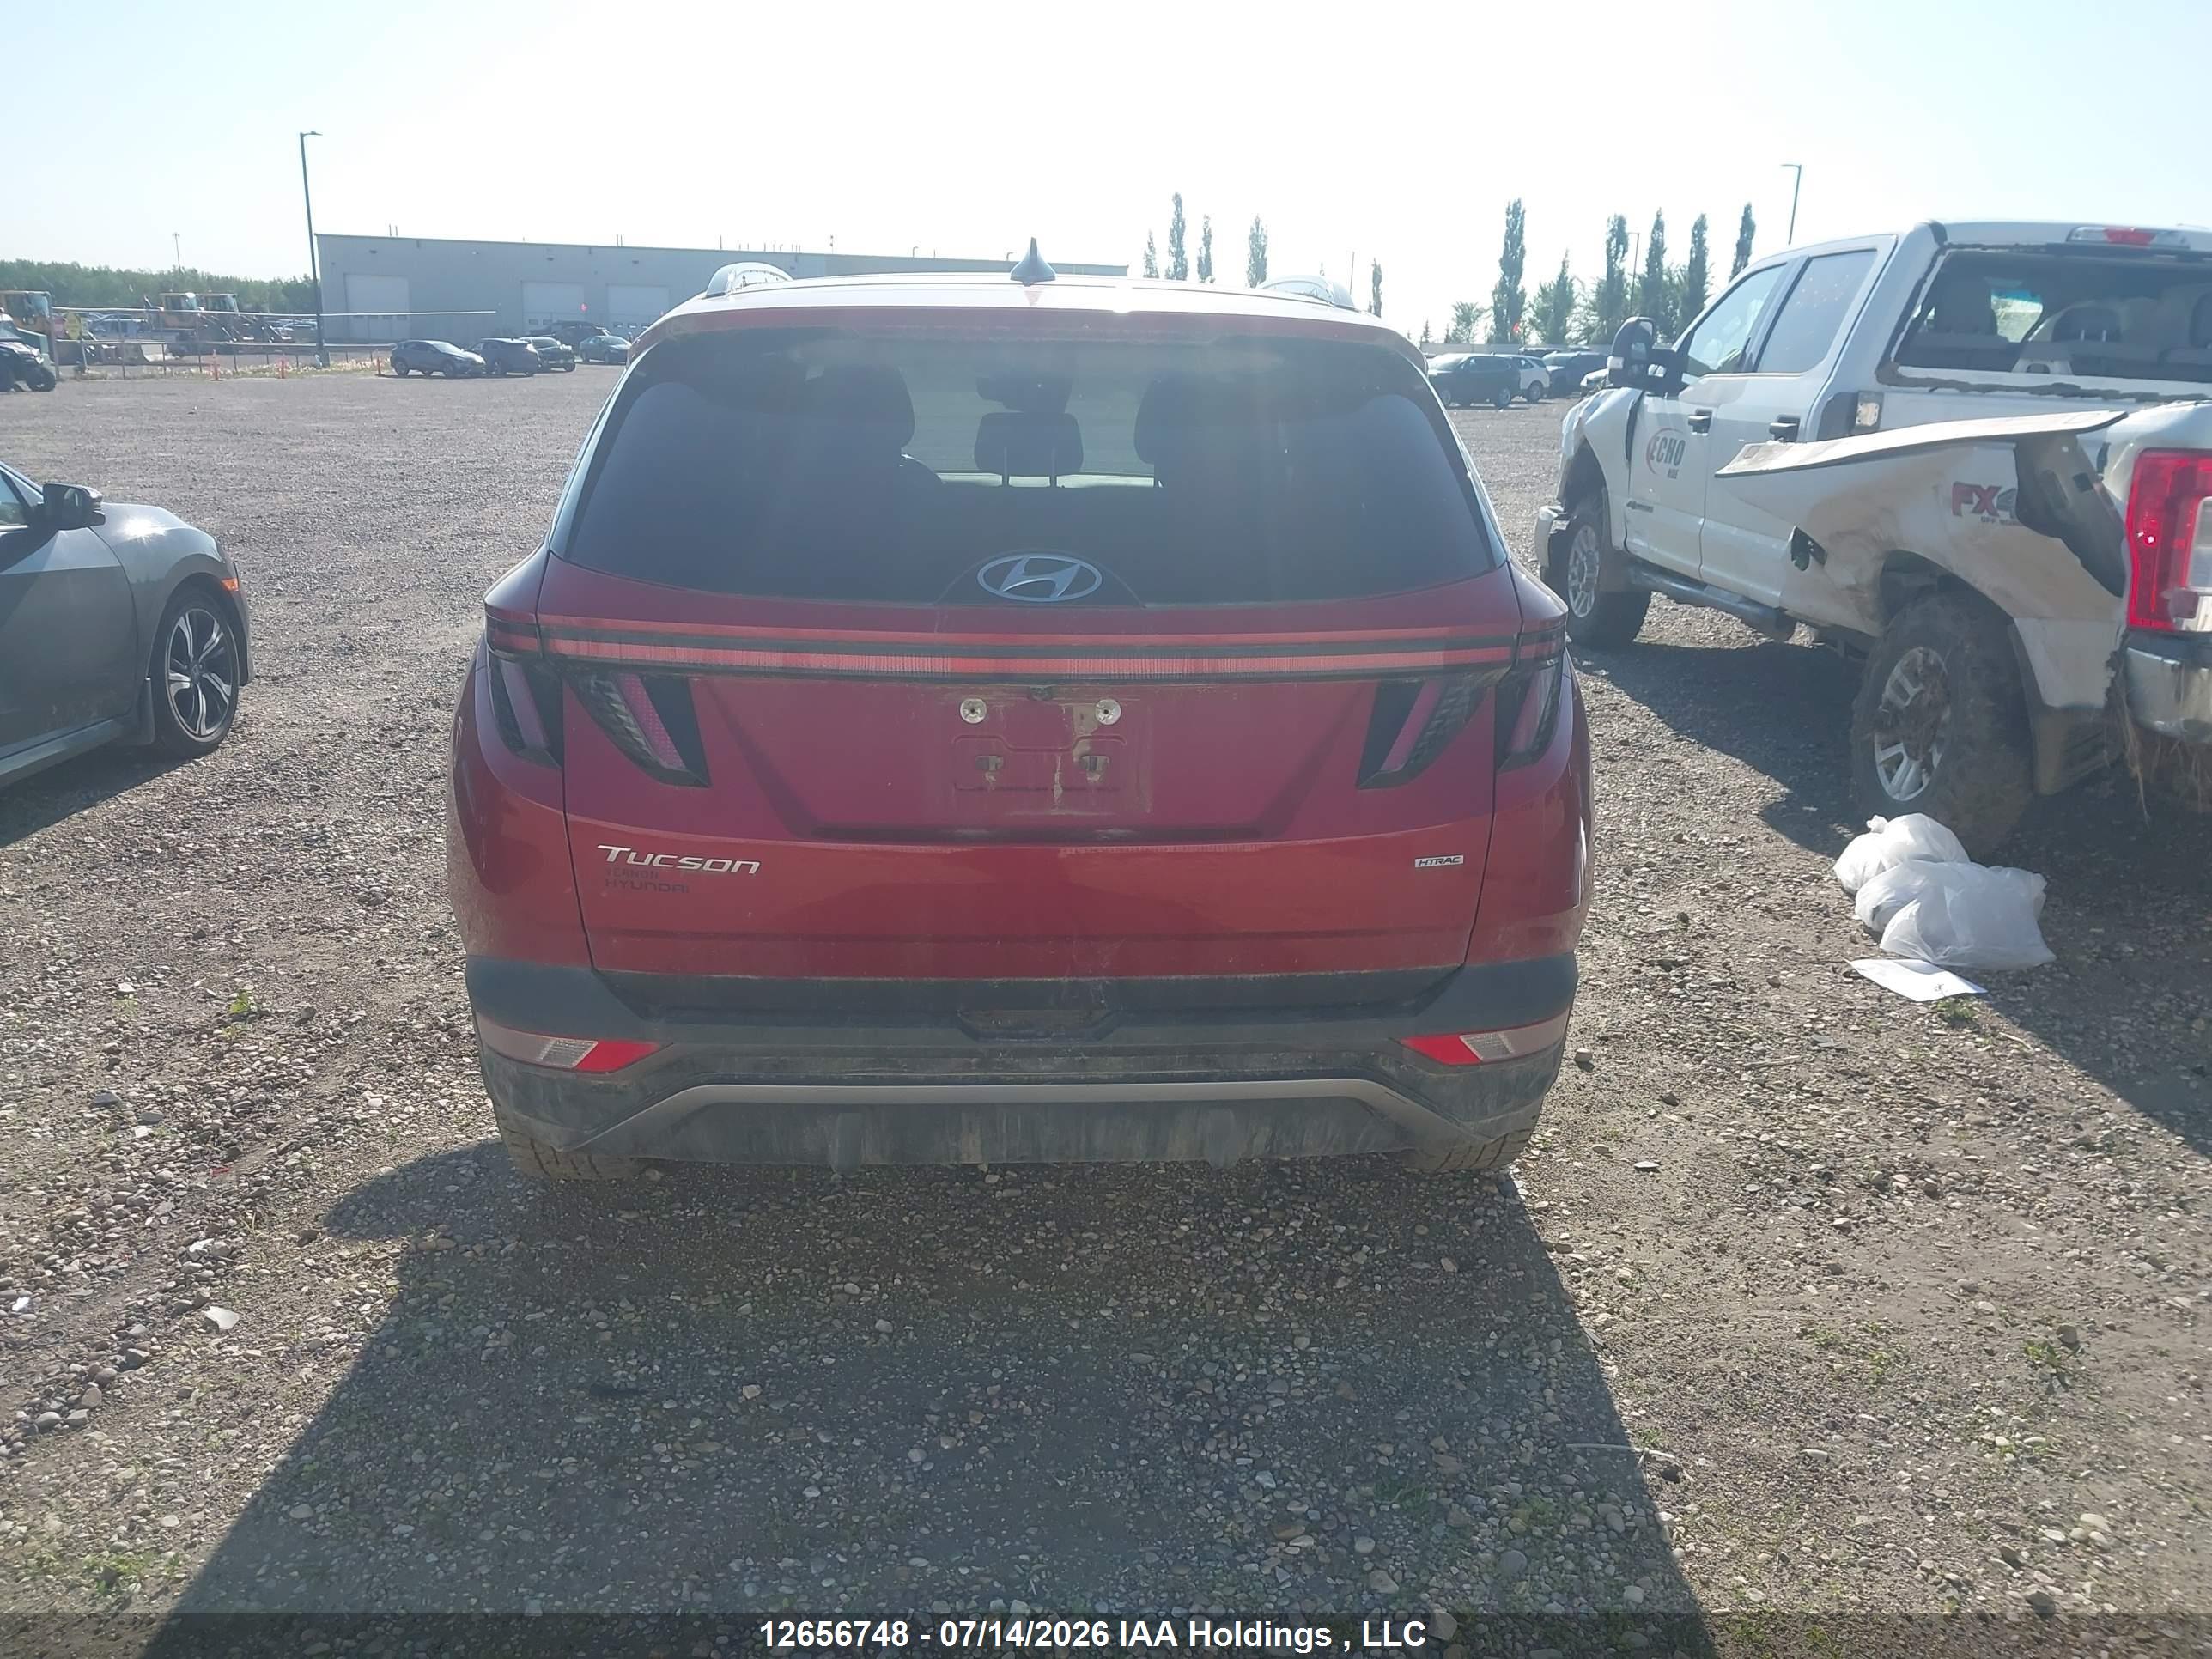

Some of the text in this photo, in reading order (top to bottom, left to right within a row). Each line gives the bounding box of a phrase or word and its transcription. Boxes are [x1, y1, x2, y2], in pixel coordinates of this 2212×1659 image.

[1649, 436, 1686, 465] ECHO
[1952, 481, 2017, 519] FX4
[1419, 857, 1461, 866] HTRAC
[605, 878, 690, 894] HYUNDAI
